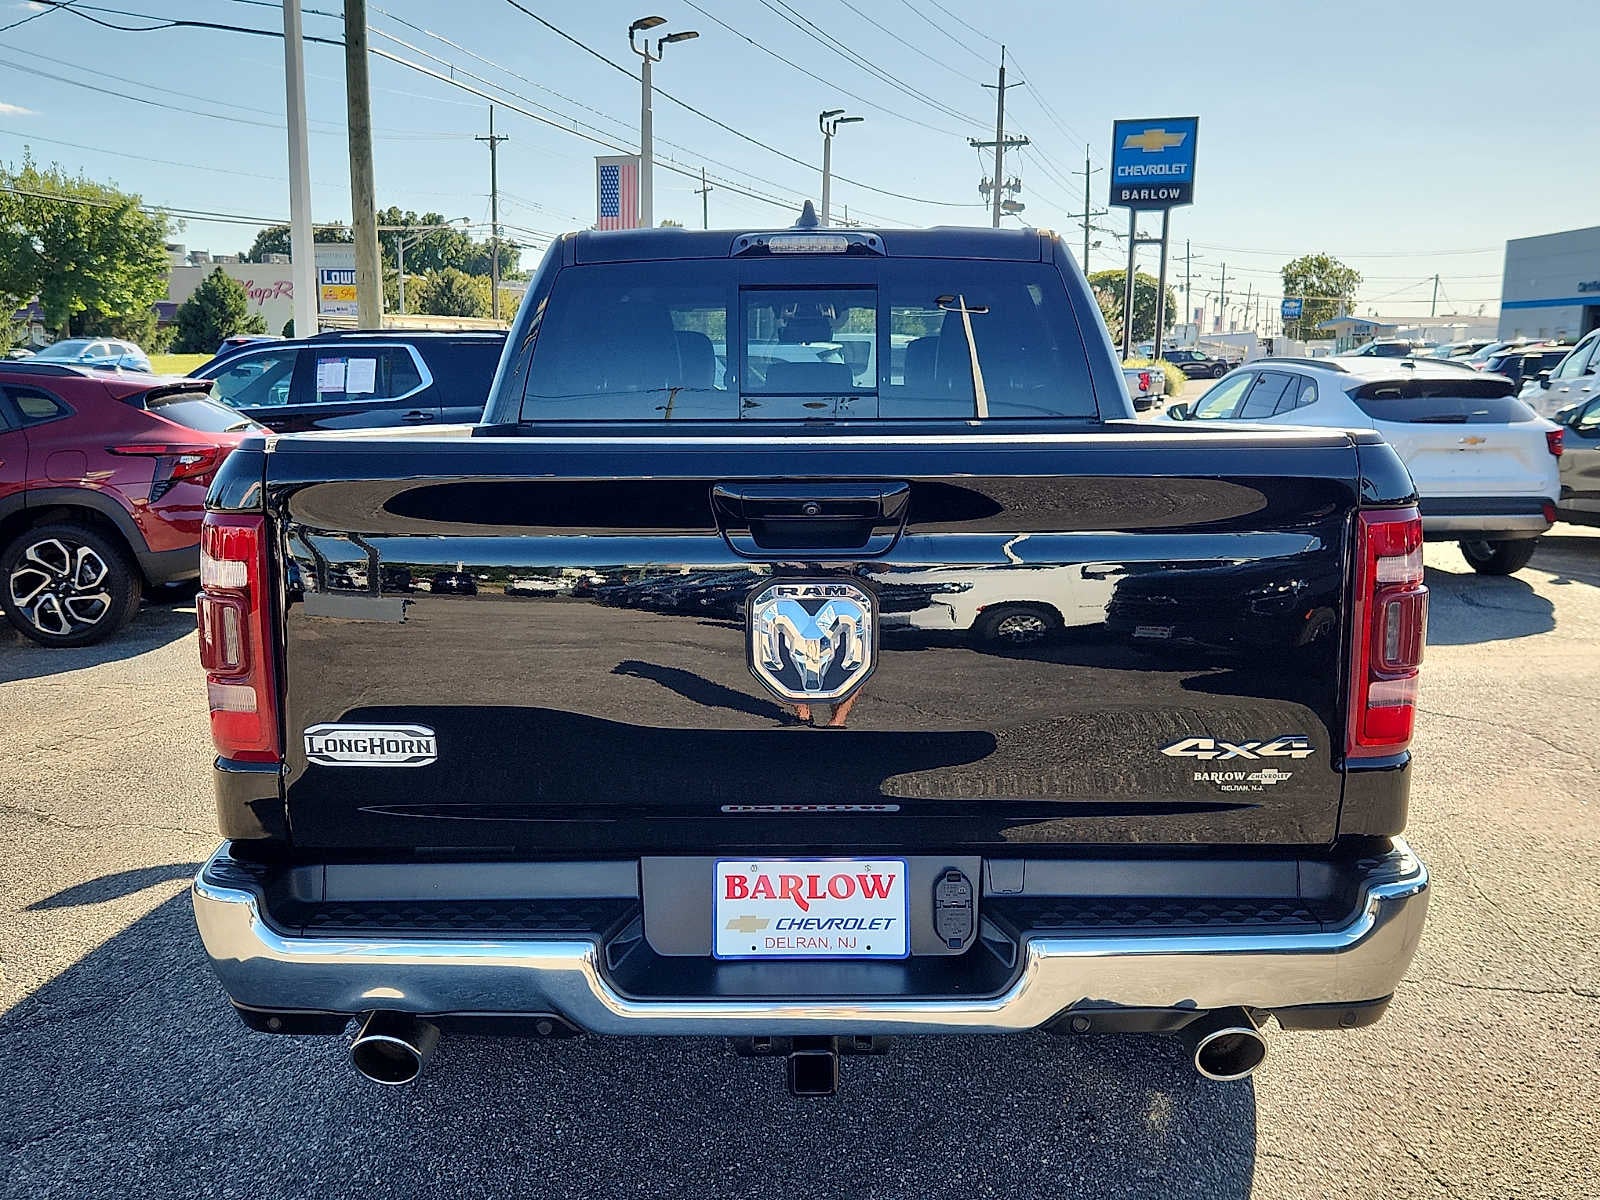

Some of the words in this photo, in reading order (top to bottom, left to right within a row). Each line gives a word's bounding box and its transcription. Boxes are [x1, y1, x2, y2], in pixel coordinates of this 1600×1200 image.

[1117, 163, 1188, 176] CHEVROLET
[1121, 188, 1180, 200] BARLOW
[777, 587, 848, 596] RAM
[1193, 771, 1246, 784] BARLOW
[724, 874, 896, 912] BARLOW
[775, 918, 897, 930] CHEVROLET
[765, 937, 833, 950] DELRAN,
[838, 937, 857, 949] NJ
